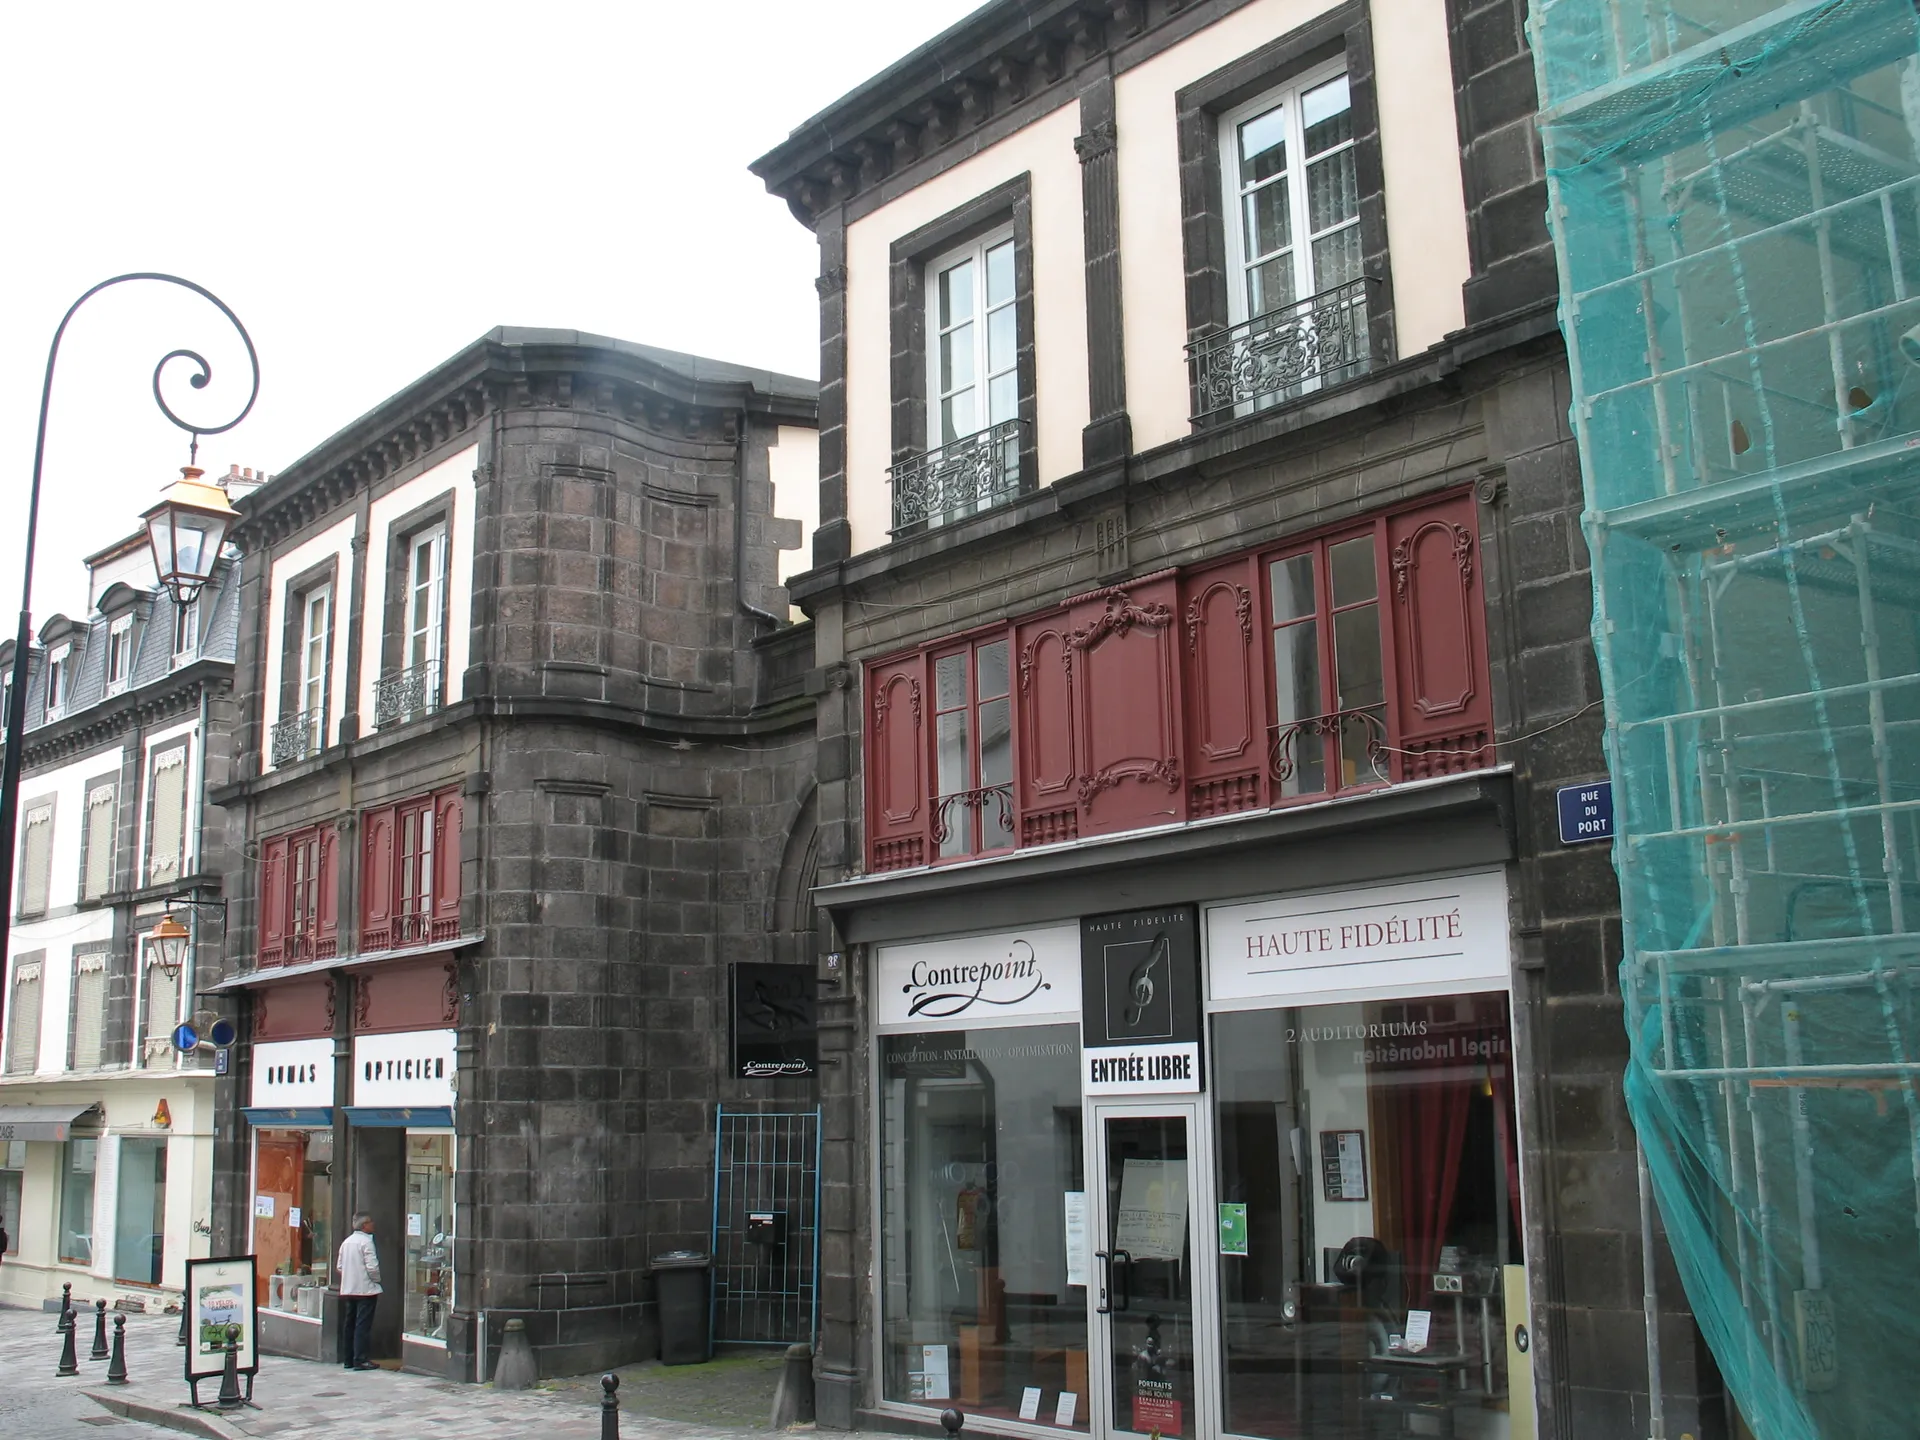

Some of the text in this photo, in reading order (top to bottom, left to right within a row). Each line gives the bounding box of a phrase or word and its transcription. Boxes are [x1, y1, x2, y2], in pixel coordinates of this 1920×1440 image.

[1581, 790, 1599, 802] RUE
[1584, 805, 1598, 816] DU
[1578, 818, 1607, 834] PORT
[1088, 913, 1184, 932] HAUTE FIDELITE
[1246, 908, 1463, 959] HAUTE FIDÉLITÉ
[910, 940, 1040, 1005] Contrepoint
[1285, 1020, 1428, 1043] 2 AUDITORIUMS
[886, 1043, 1073, 1064] CONCEPTION INSTALLATION OPTIMISATION
[365, 1057, 444, 1082] OPTICIEN
[744, 1059, 808, 1073] Contrepoint
[1091, 1052, 1191, 1082] ENTRÉE LIBRE
[1138, 1379, 1172, 1390] PORTRAITS
